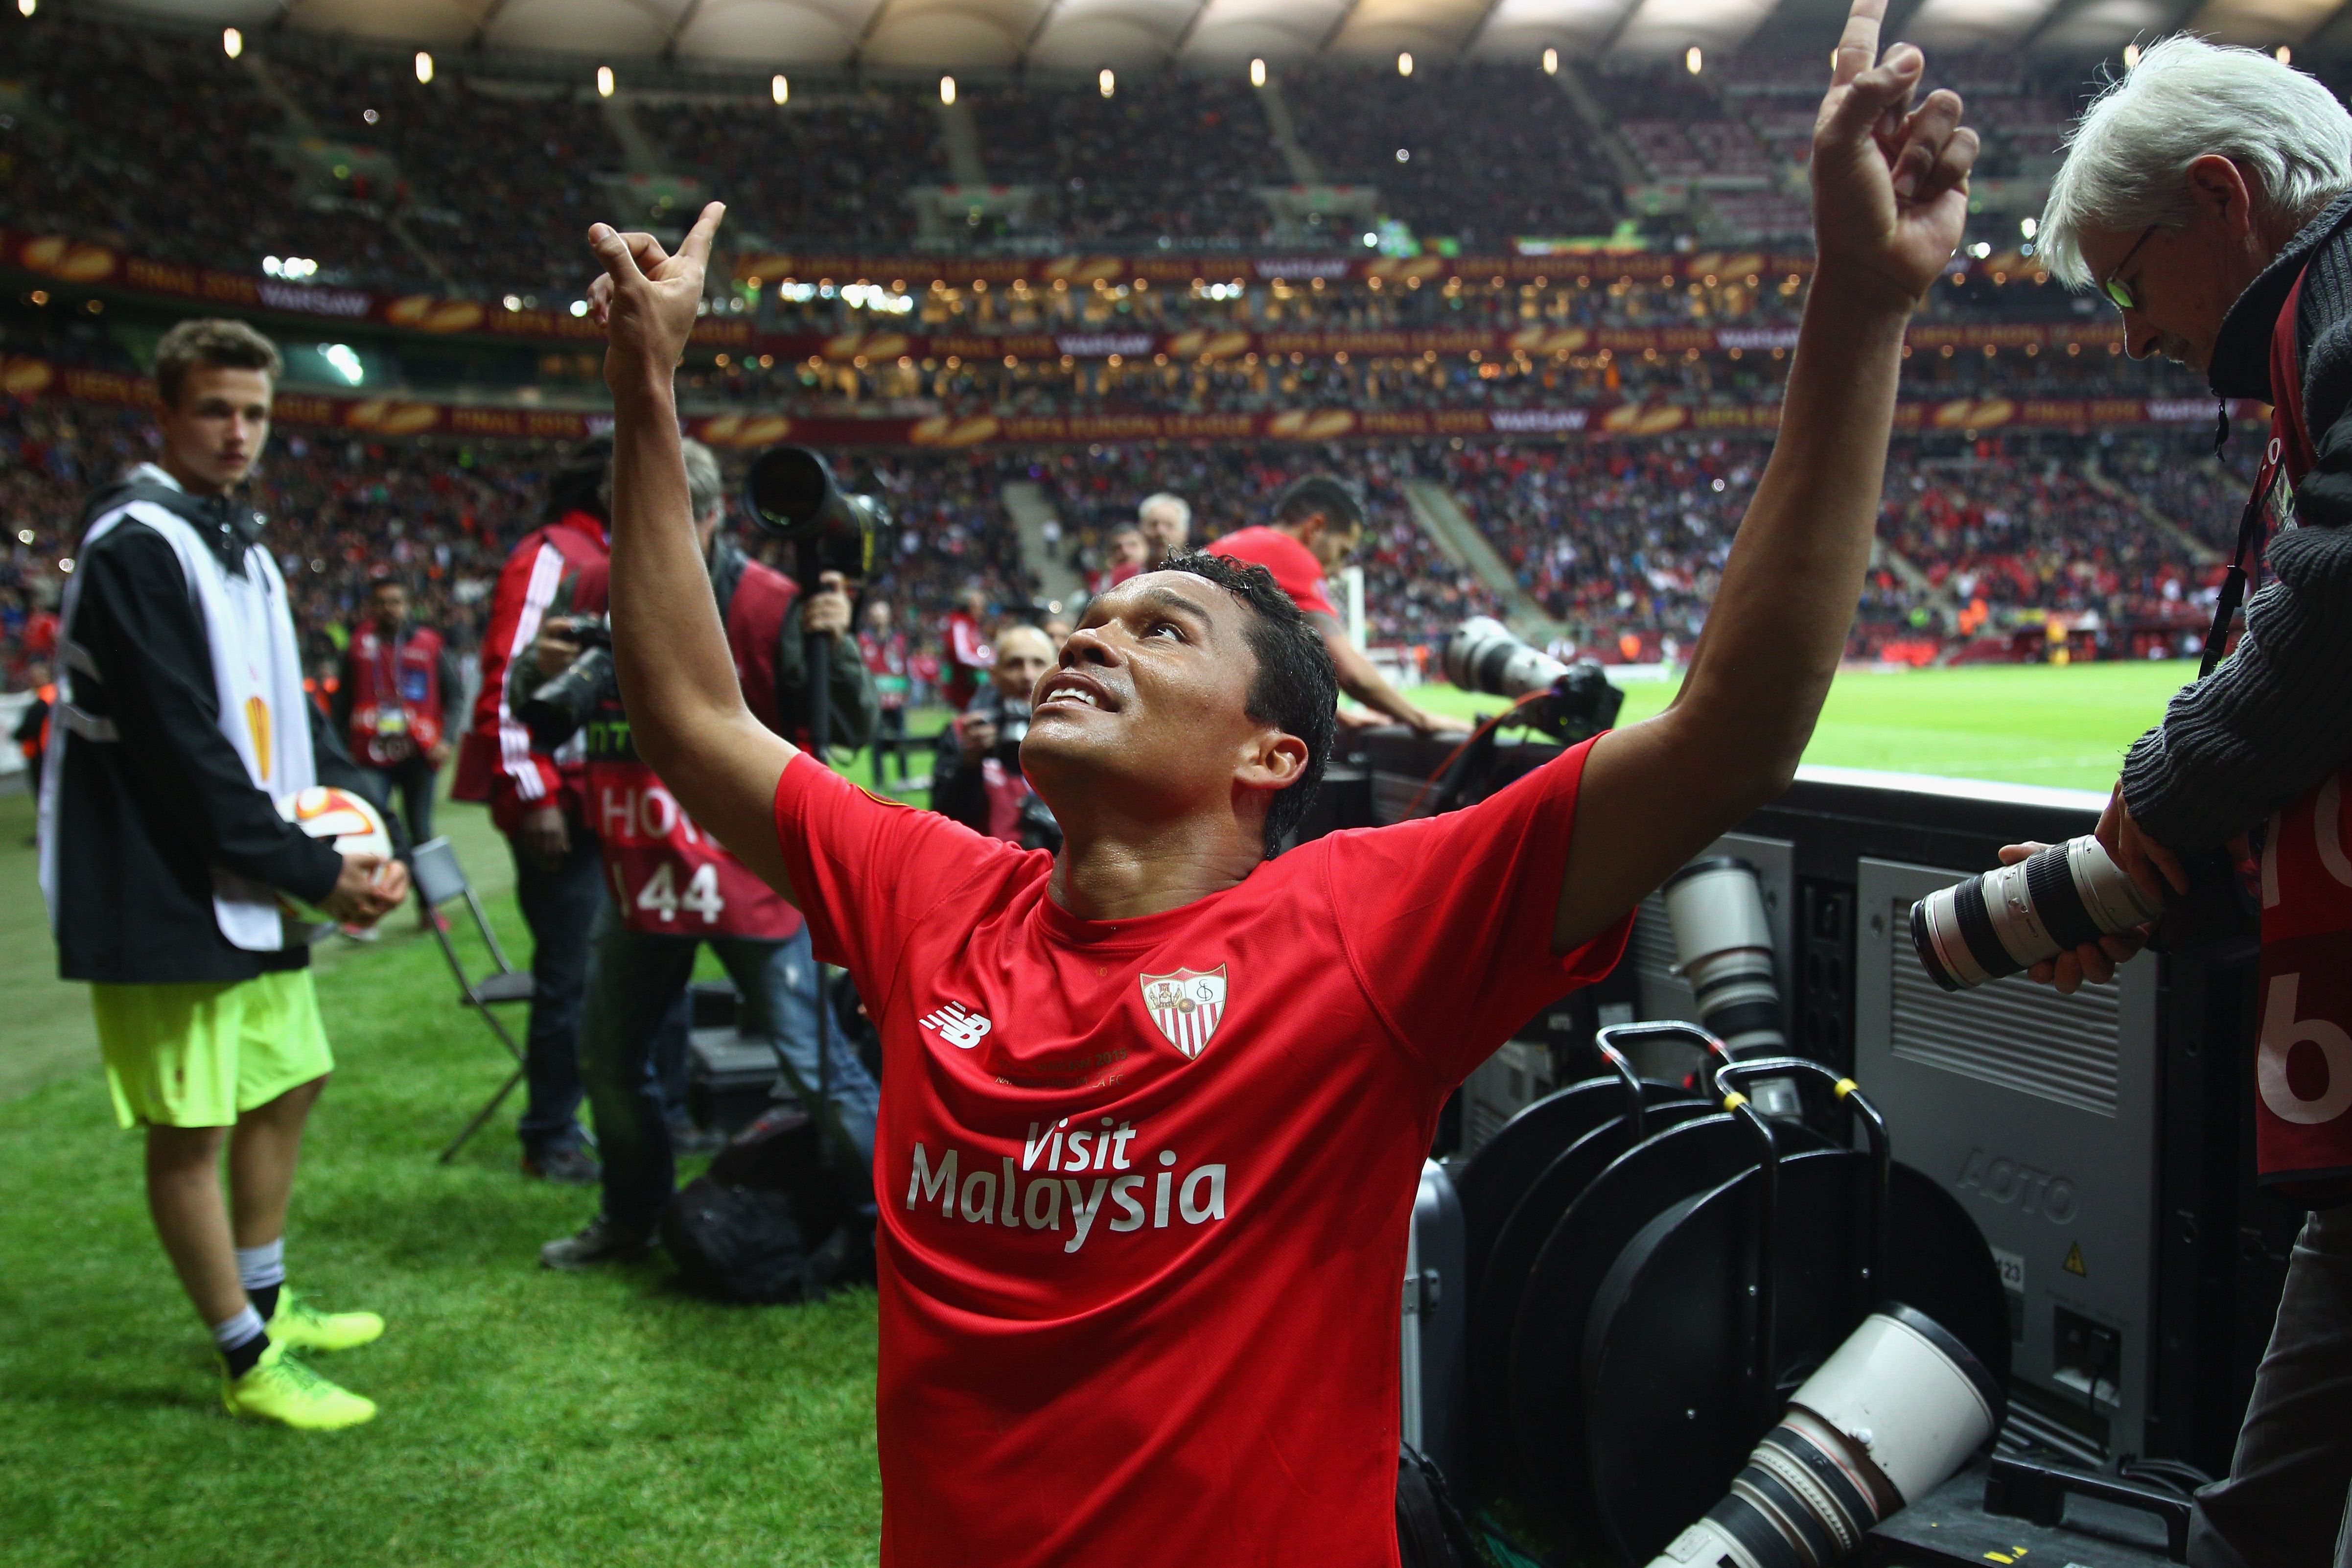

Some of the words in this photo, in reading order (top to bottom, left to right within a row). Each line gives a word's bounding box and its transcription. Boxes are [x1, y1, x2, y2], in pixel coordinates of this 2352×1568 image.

[1095, 1047, 1128, 1066] 2015
[1022, 1117, 1137, 1171] Visit
[906, 1142, 1226, 1253] Malaysia
[1956, 1147, 2079, 1225] AOTO
